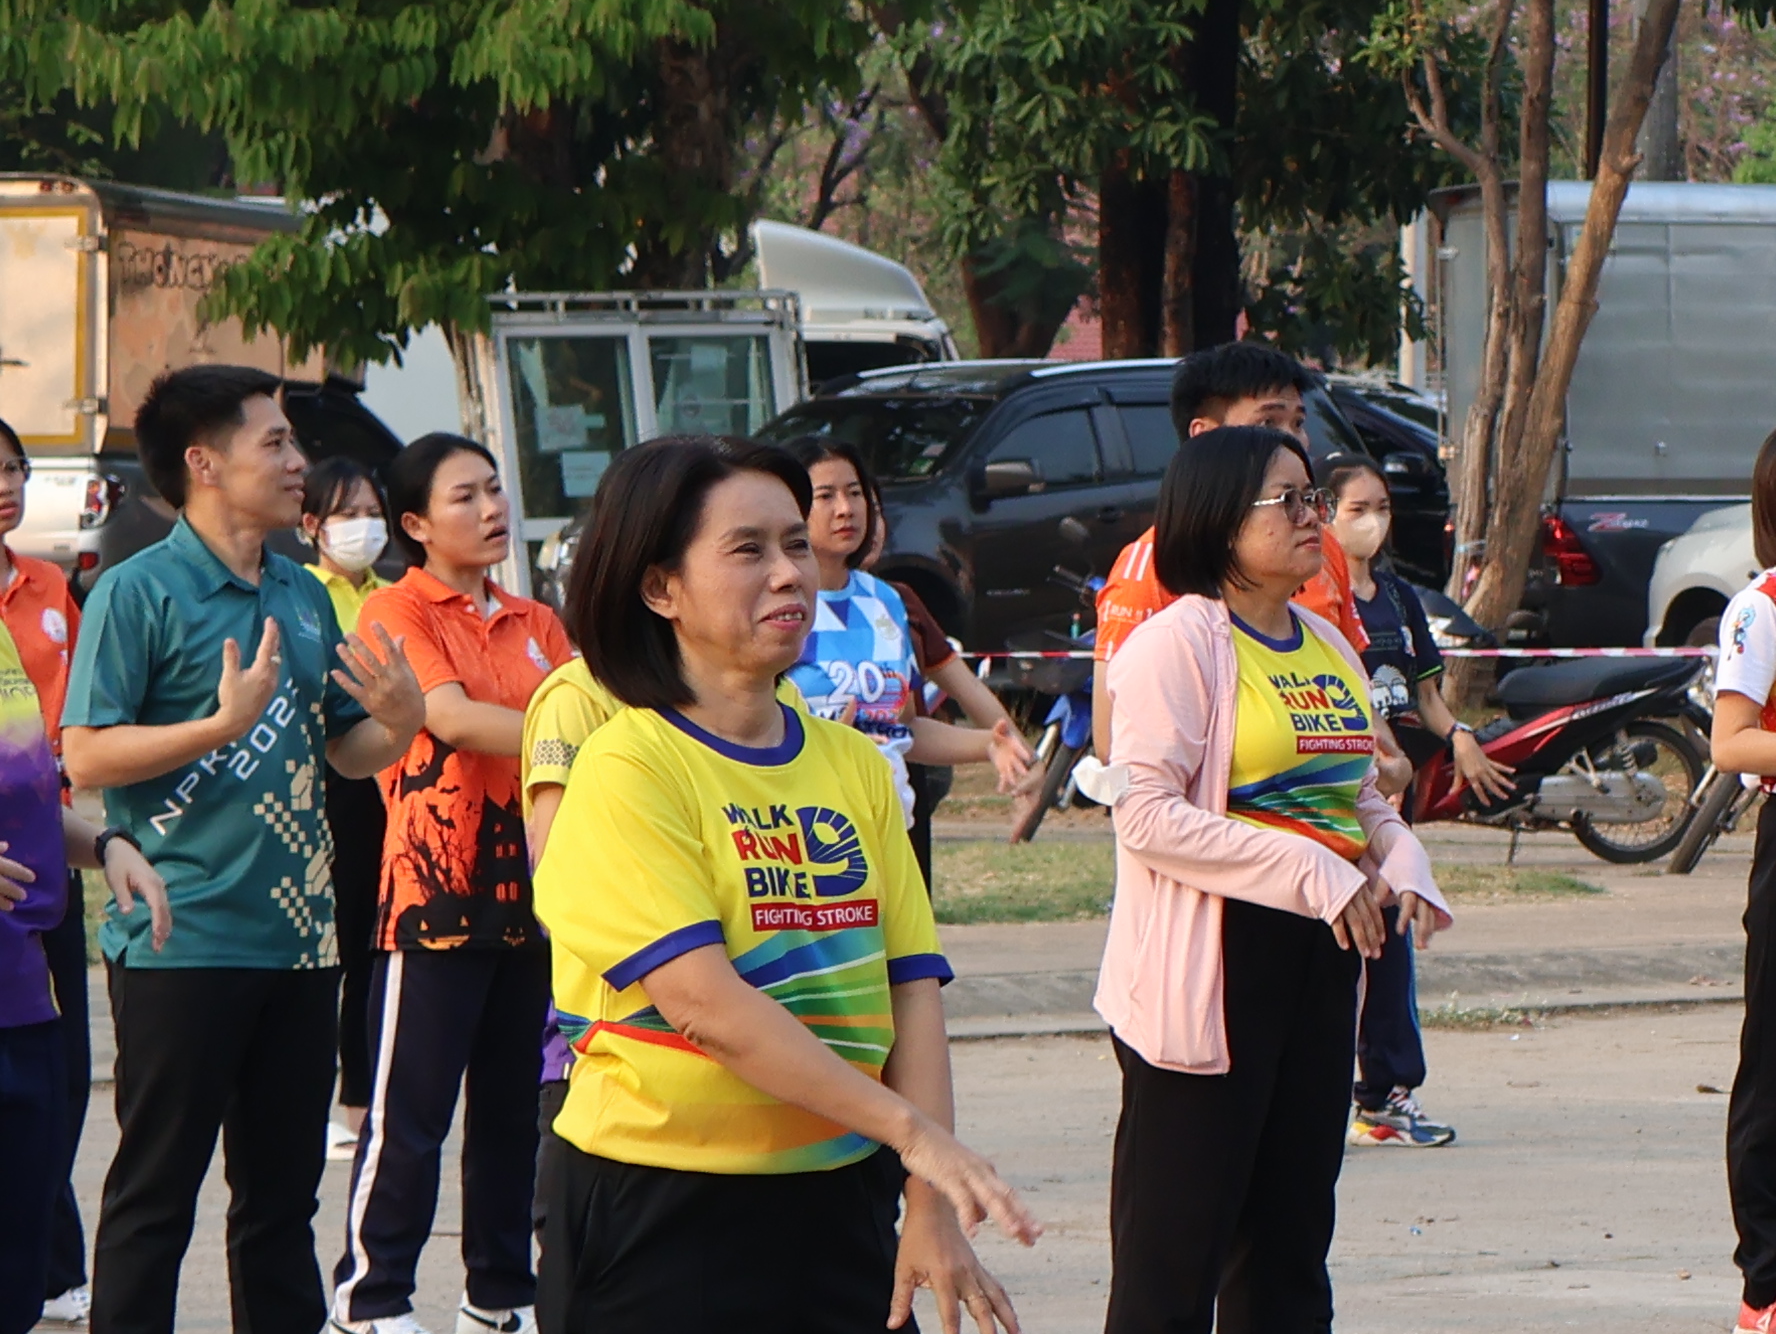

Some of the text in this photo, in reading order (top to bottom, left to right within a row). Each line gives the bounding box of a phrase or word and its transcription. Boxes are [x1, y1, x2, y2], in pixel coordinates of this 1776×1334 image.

[1289, 713, 1343, 733] BIKE
[1299, 738, 1346, 751] FIGHTING
[731, 829, 803, 866] RUN
[744, 866, 812, 900] BIKE
[816, 905, 874, 926] STROKE
